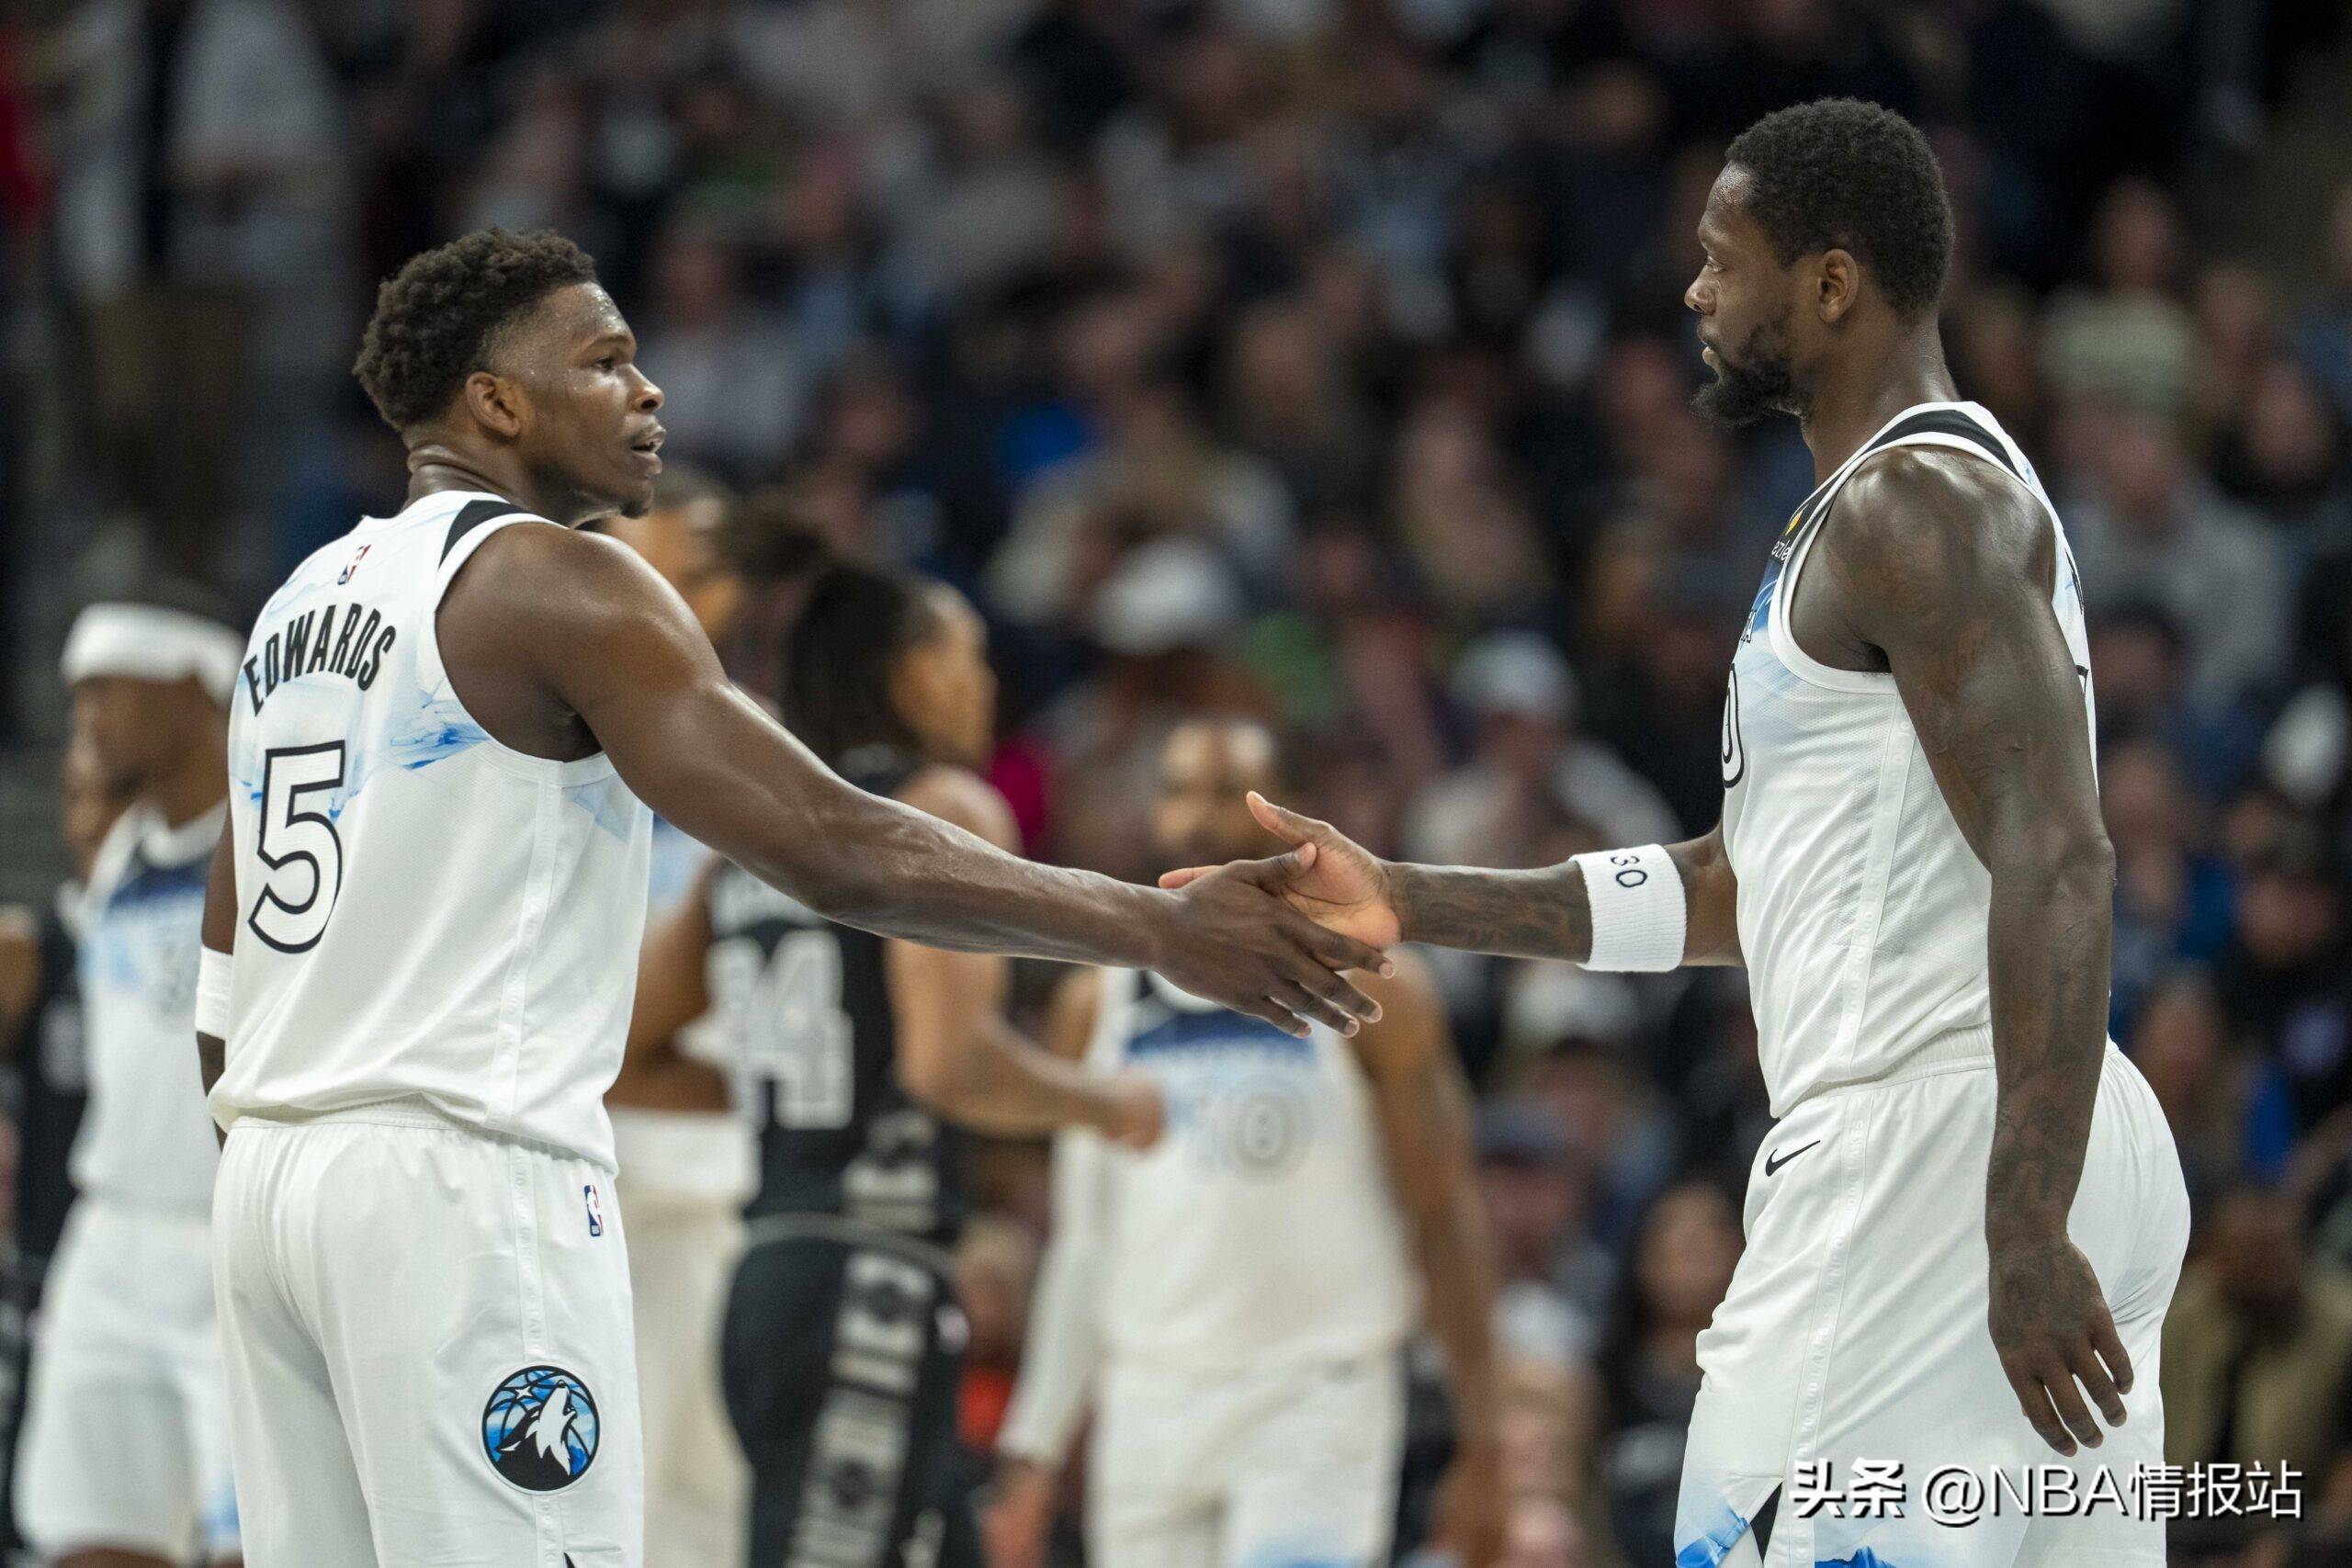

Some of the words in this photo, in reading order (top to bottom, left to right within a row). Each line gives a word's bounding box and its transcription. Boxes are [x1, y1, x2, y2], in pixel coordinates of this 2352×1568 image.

[243, 603, 396, 717] EDWARDS
[248, 739, 345, 955] 5
[1610, 855, 1647, 888] 30
